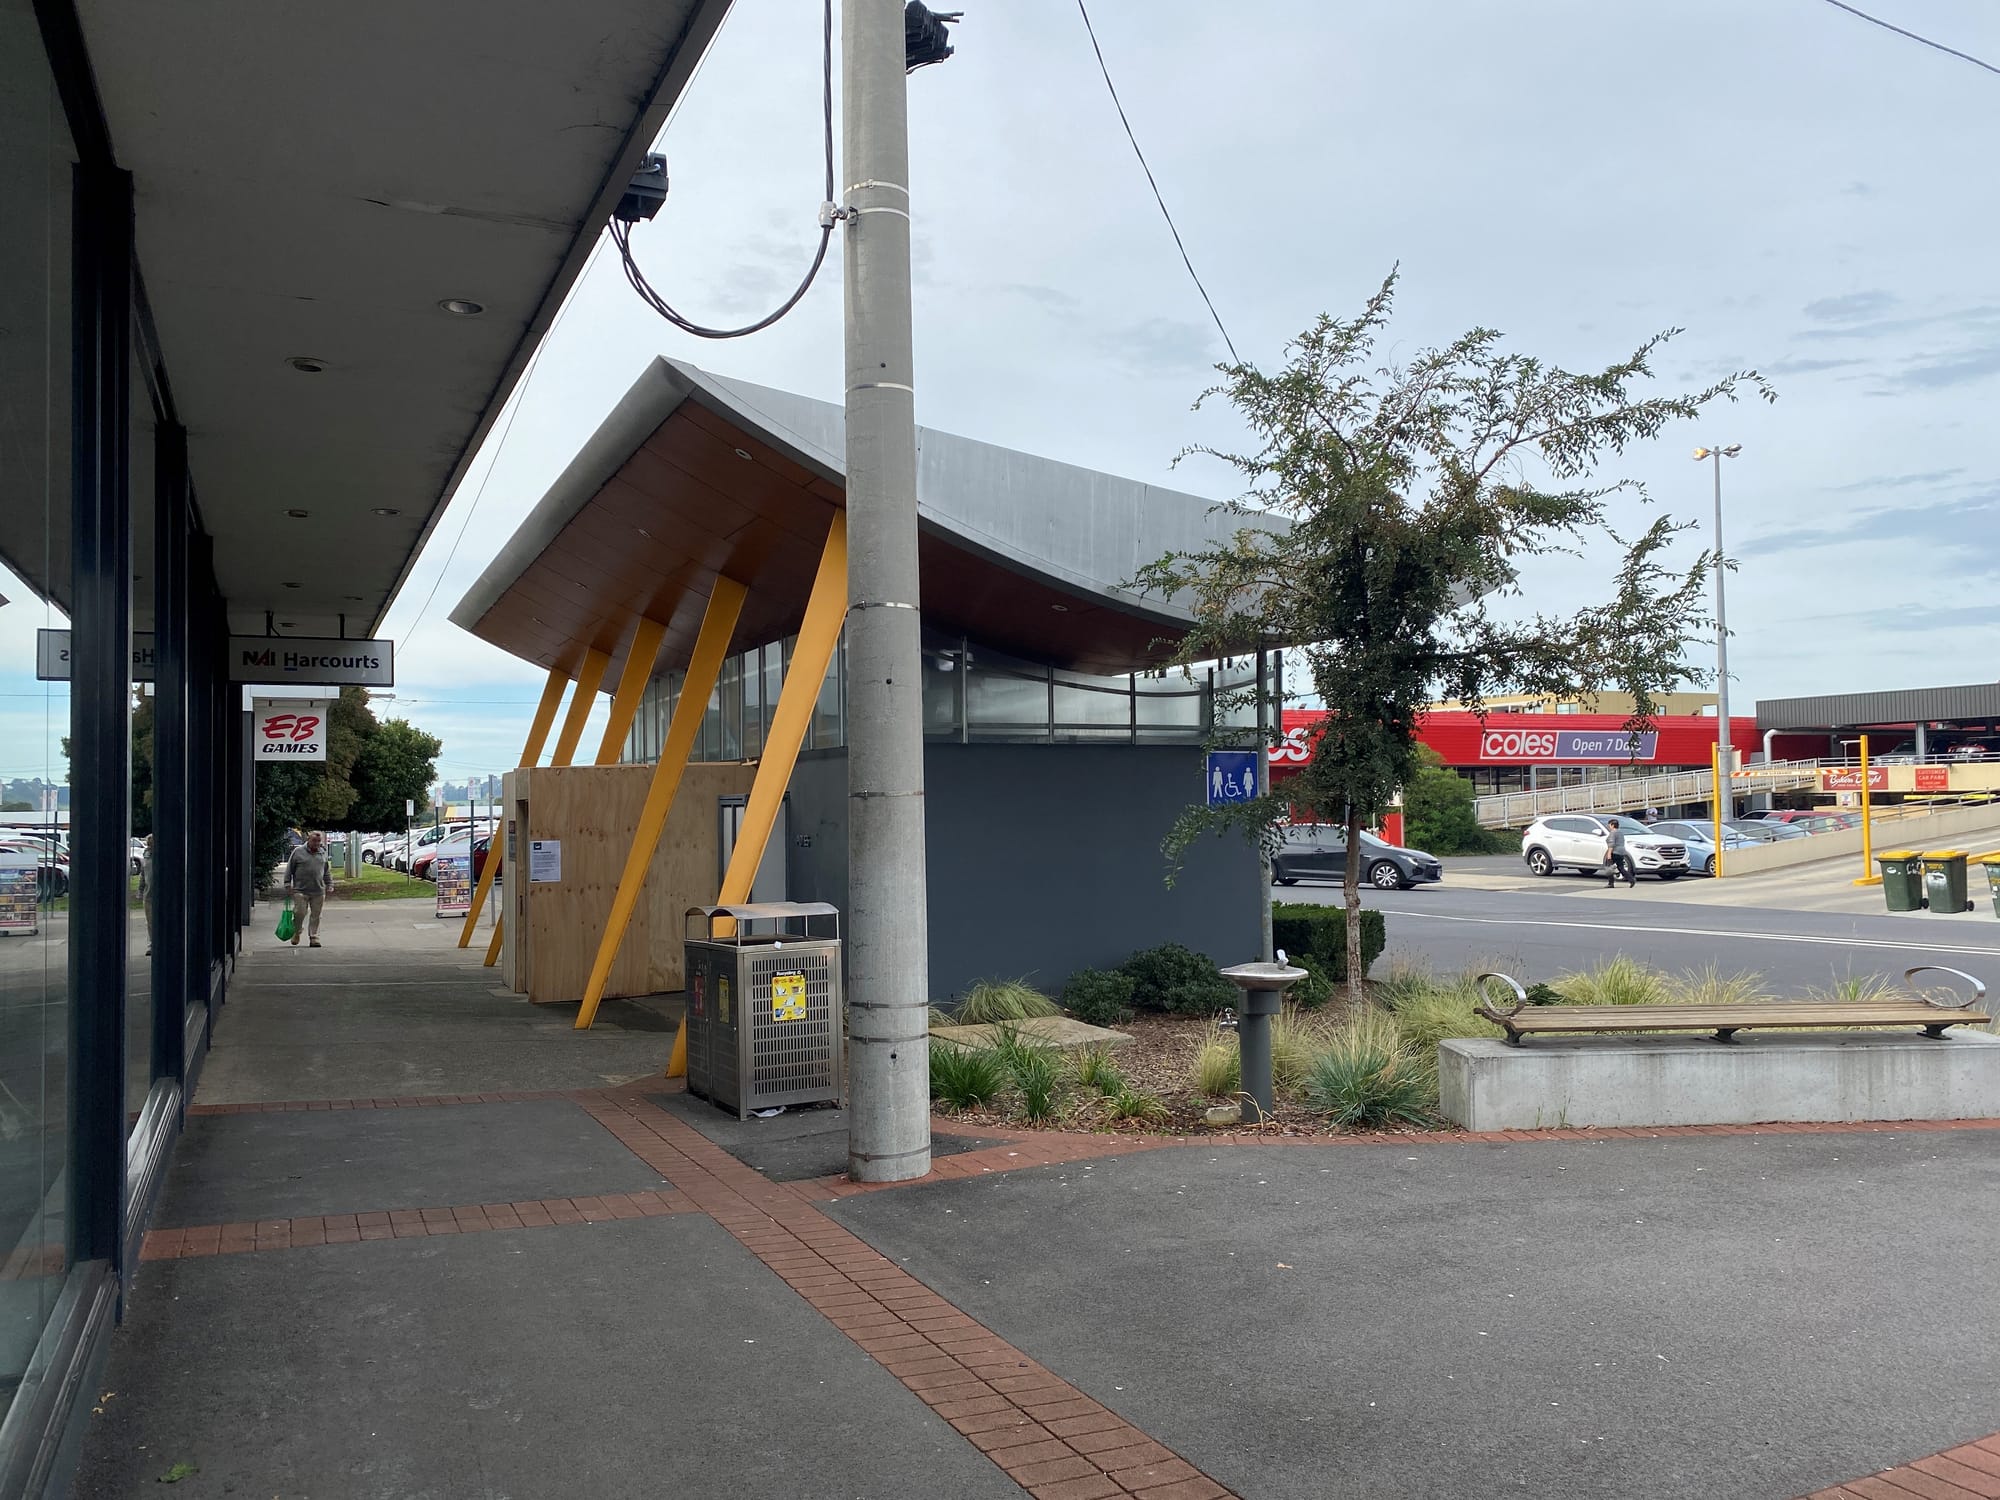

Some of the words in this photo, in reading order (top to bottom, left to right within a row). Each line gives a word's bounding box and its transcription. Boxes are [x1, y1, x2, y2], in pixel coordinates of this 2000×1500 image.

[242, 649, 276, 666] NAI
[284, 652, 379, 669] Harcourts
[262, 714, 320, 742] EB
[262, 743, 319, 754] GAMES
[1485, 730, 1554, 755] coles
[1572, 738, 1602, 755] Open
[1606, 739, 1614, 751] 7
